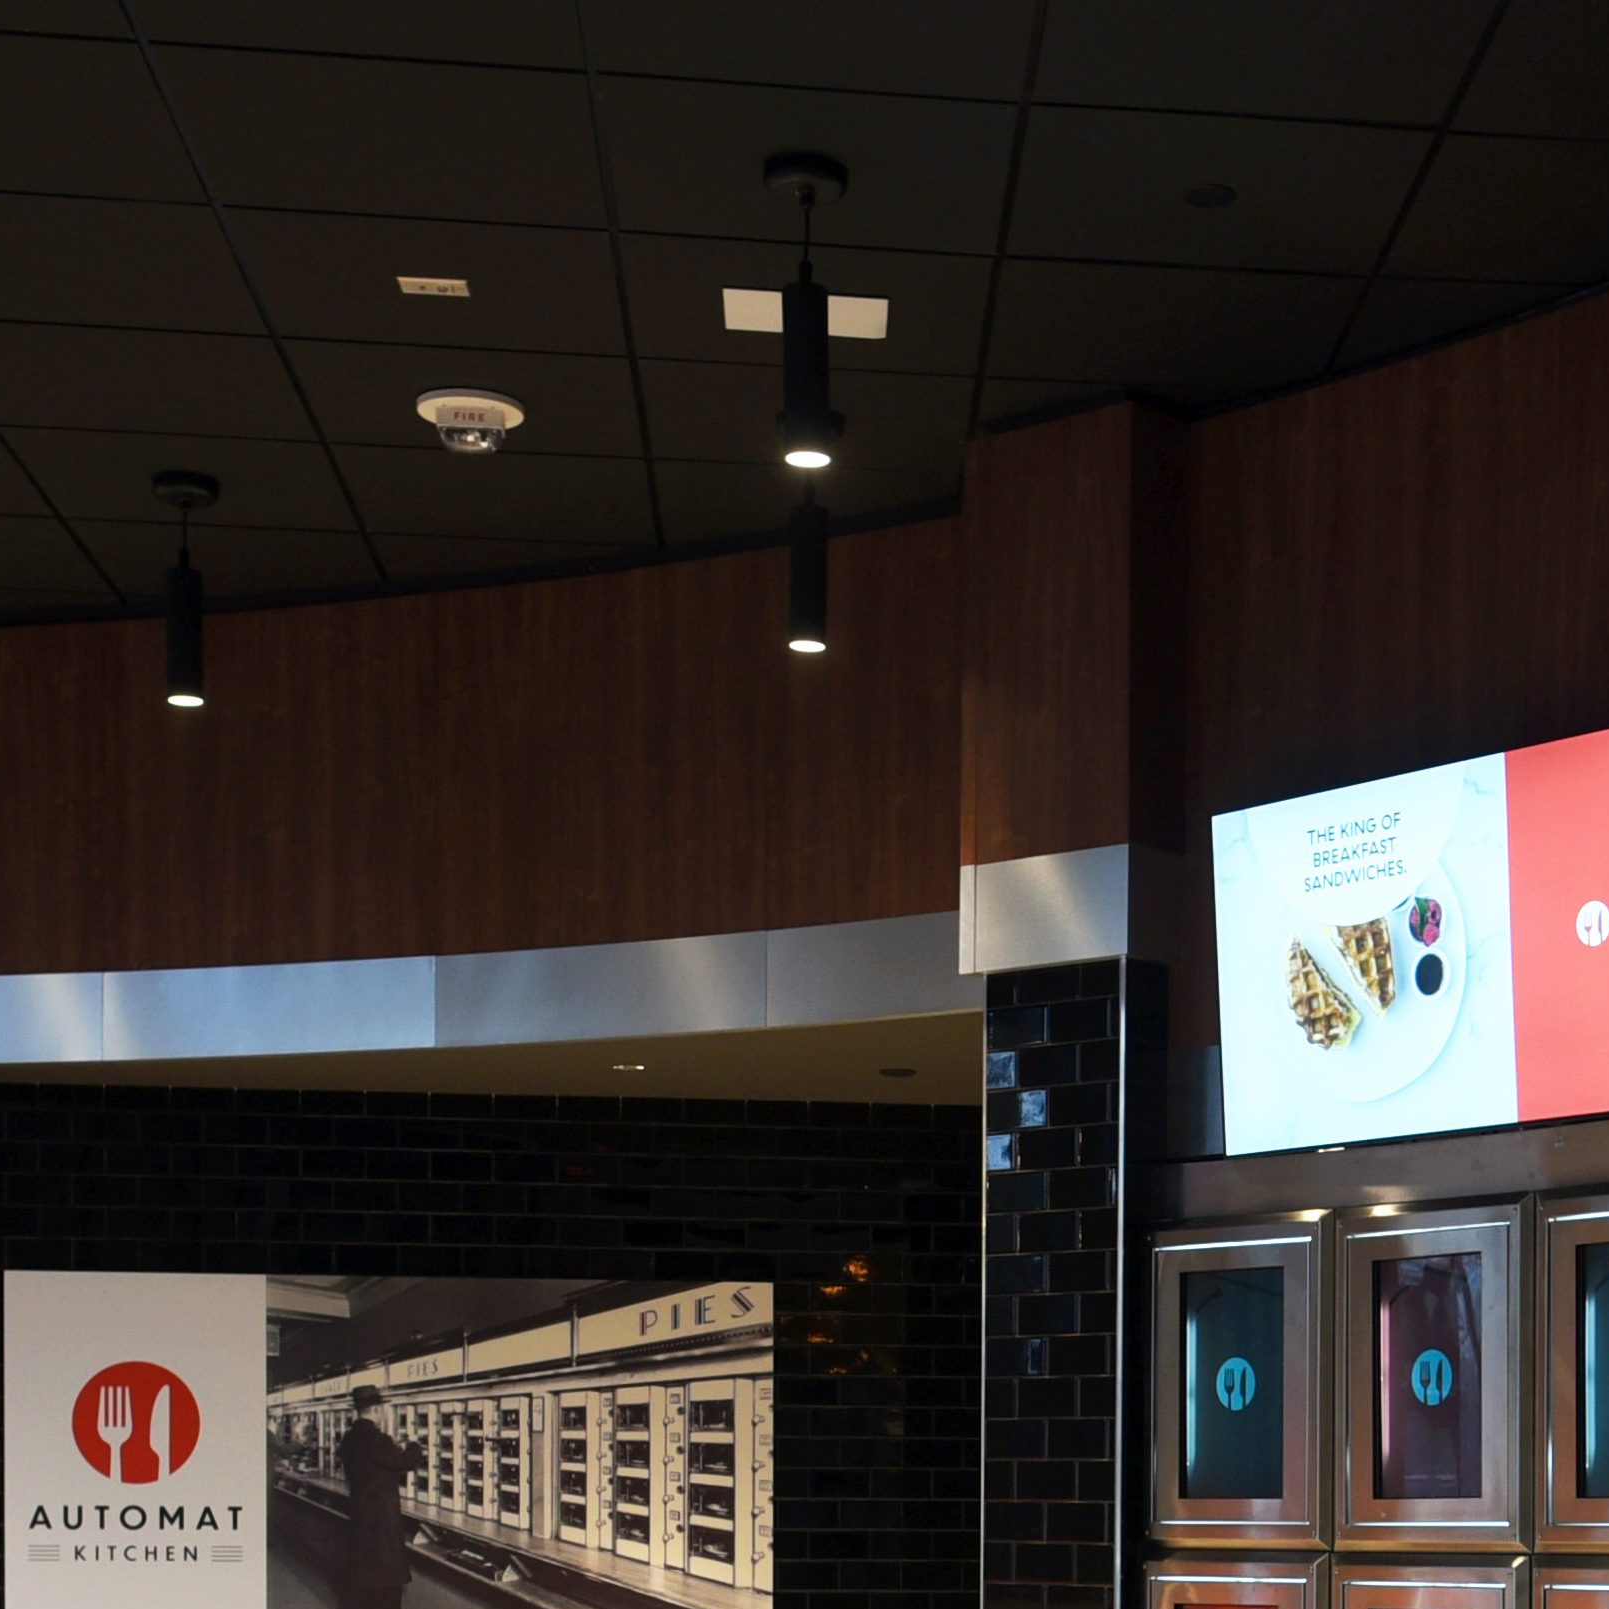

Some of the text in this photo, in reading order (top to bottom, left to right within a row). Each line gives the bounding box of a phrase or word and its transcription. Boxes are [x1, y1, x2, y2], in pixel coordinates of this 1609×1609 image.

[454, 412, 485, 422] FIRE
[1306, 811, 1401, 845] THE KING OF
[1313, 836, 1397, 868] BREAKFAST
[1304, 859, 1407, 893] SANDWICHES.
[638, 1285, 756, 1337] PIES
[407, 1358, 440, 1379] PIES
[29, 1505, 243, 1530] AUTOMAT
[74, 1545, 199, 1562] KITCHEN
